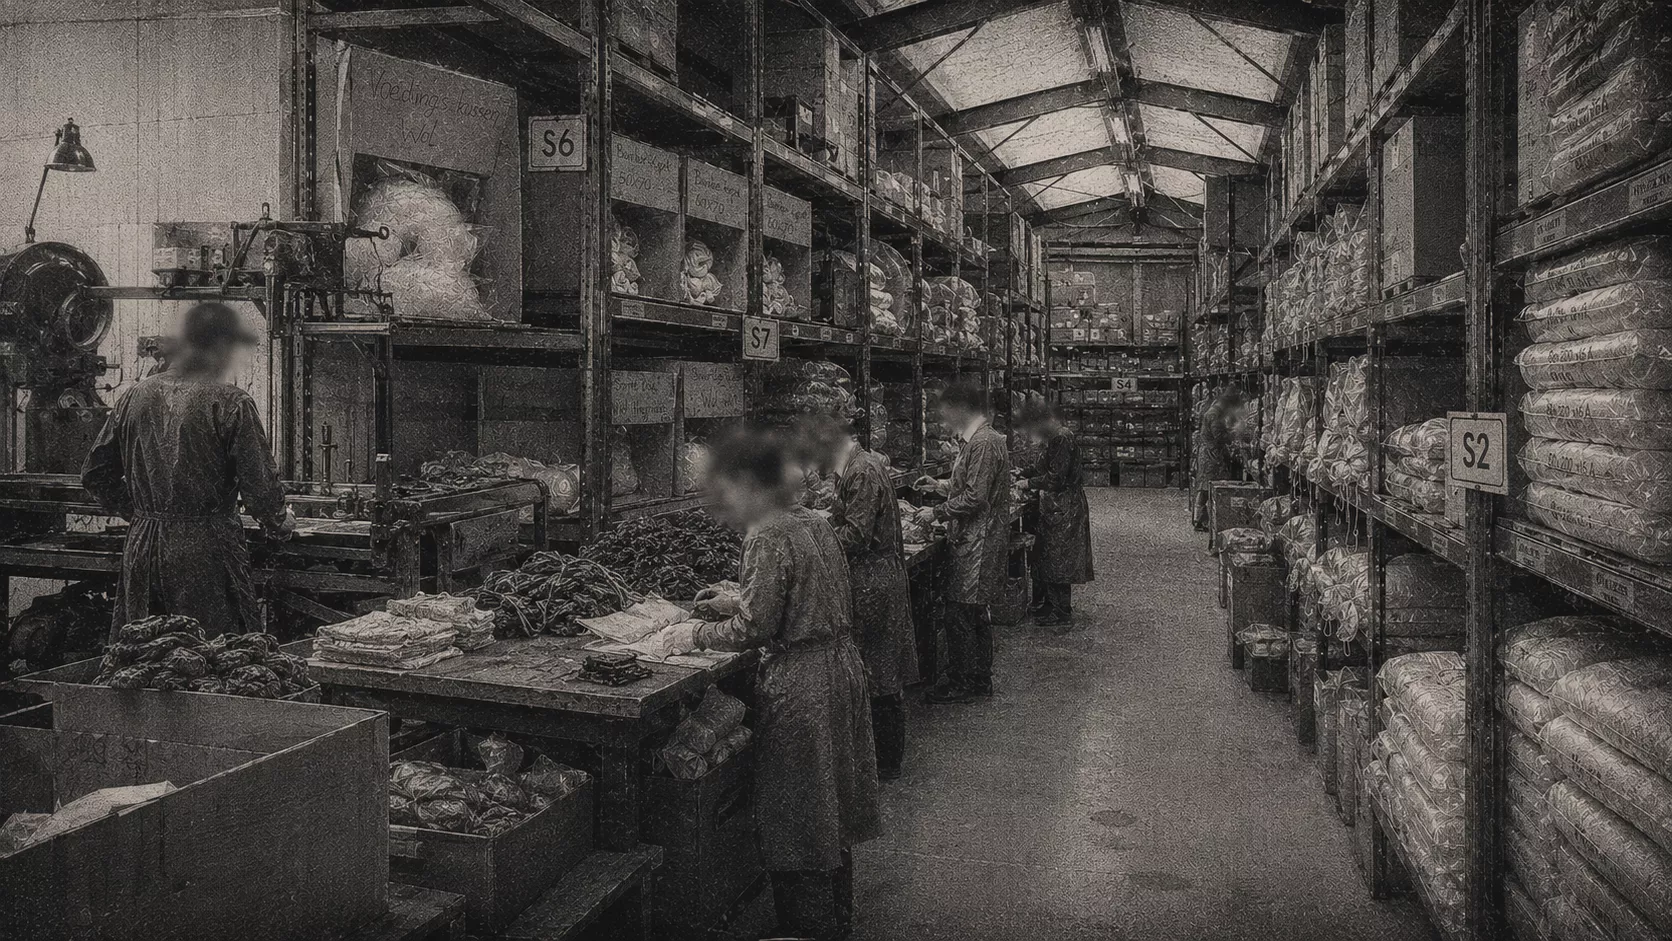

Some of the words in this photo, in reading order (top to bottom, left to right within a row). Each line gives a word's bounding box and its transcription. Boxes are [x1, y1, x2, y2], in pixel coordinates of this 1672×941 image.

[541, 128, 575, 158] S6
[750, 326, 771, 350] S7
[1116, 379, 1131, 390] S4
[1462, 431, 1490, 470] S2
